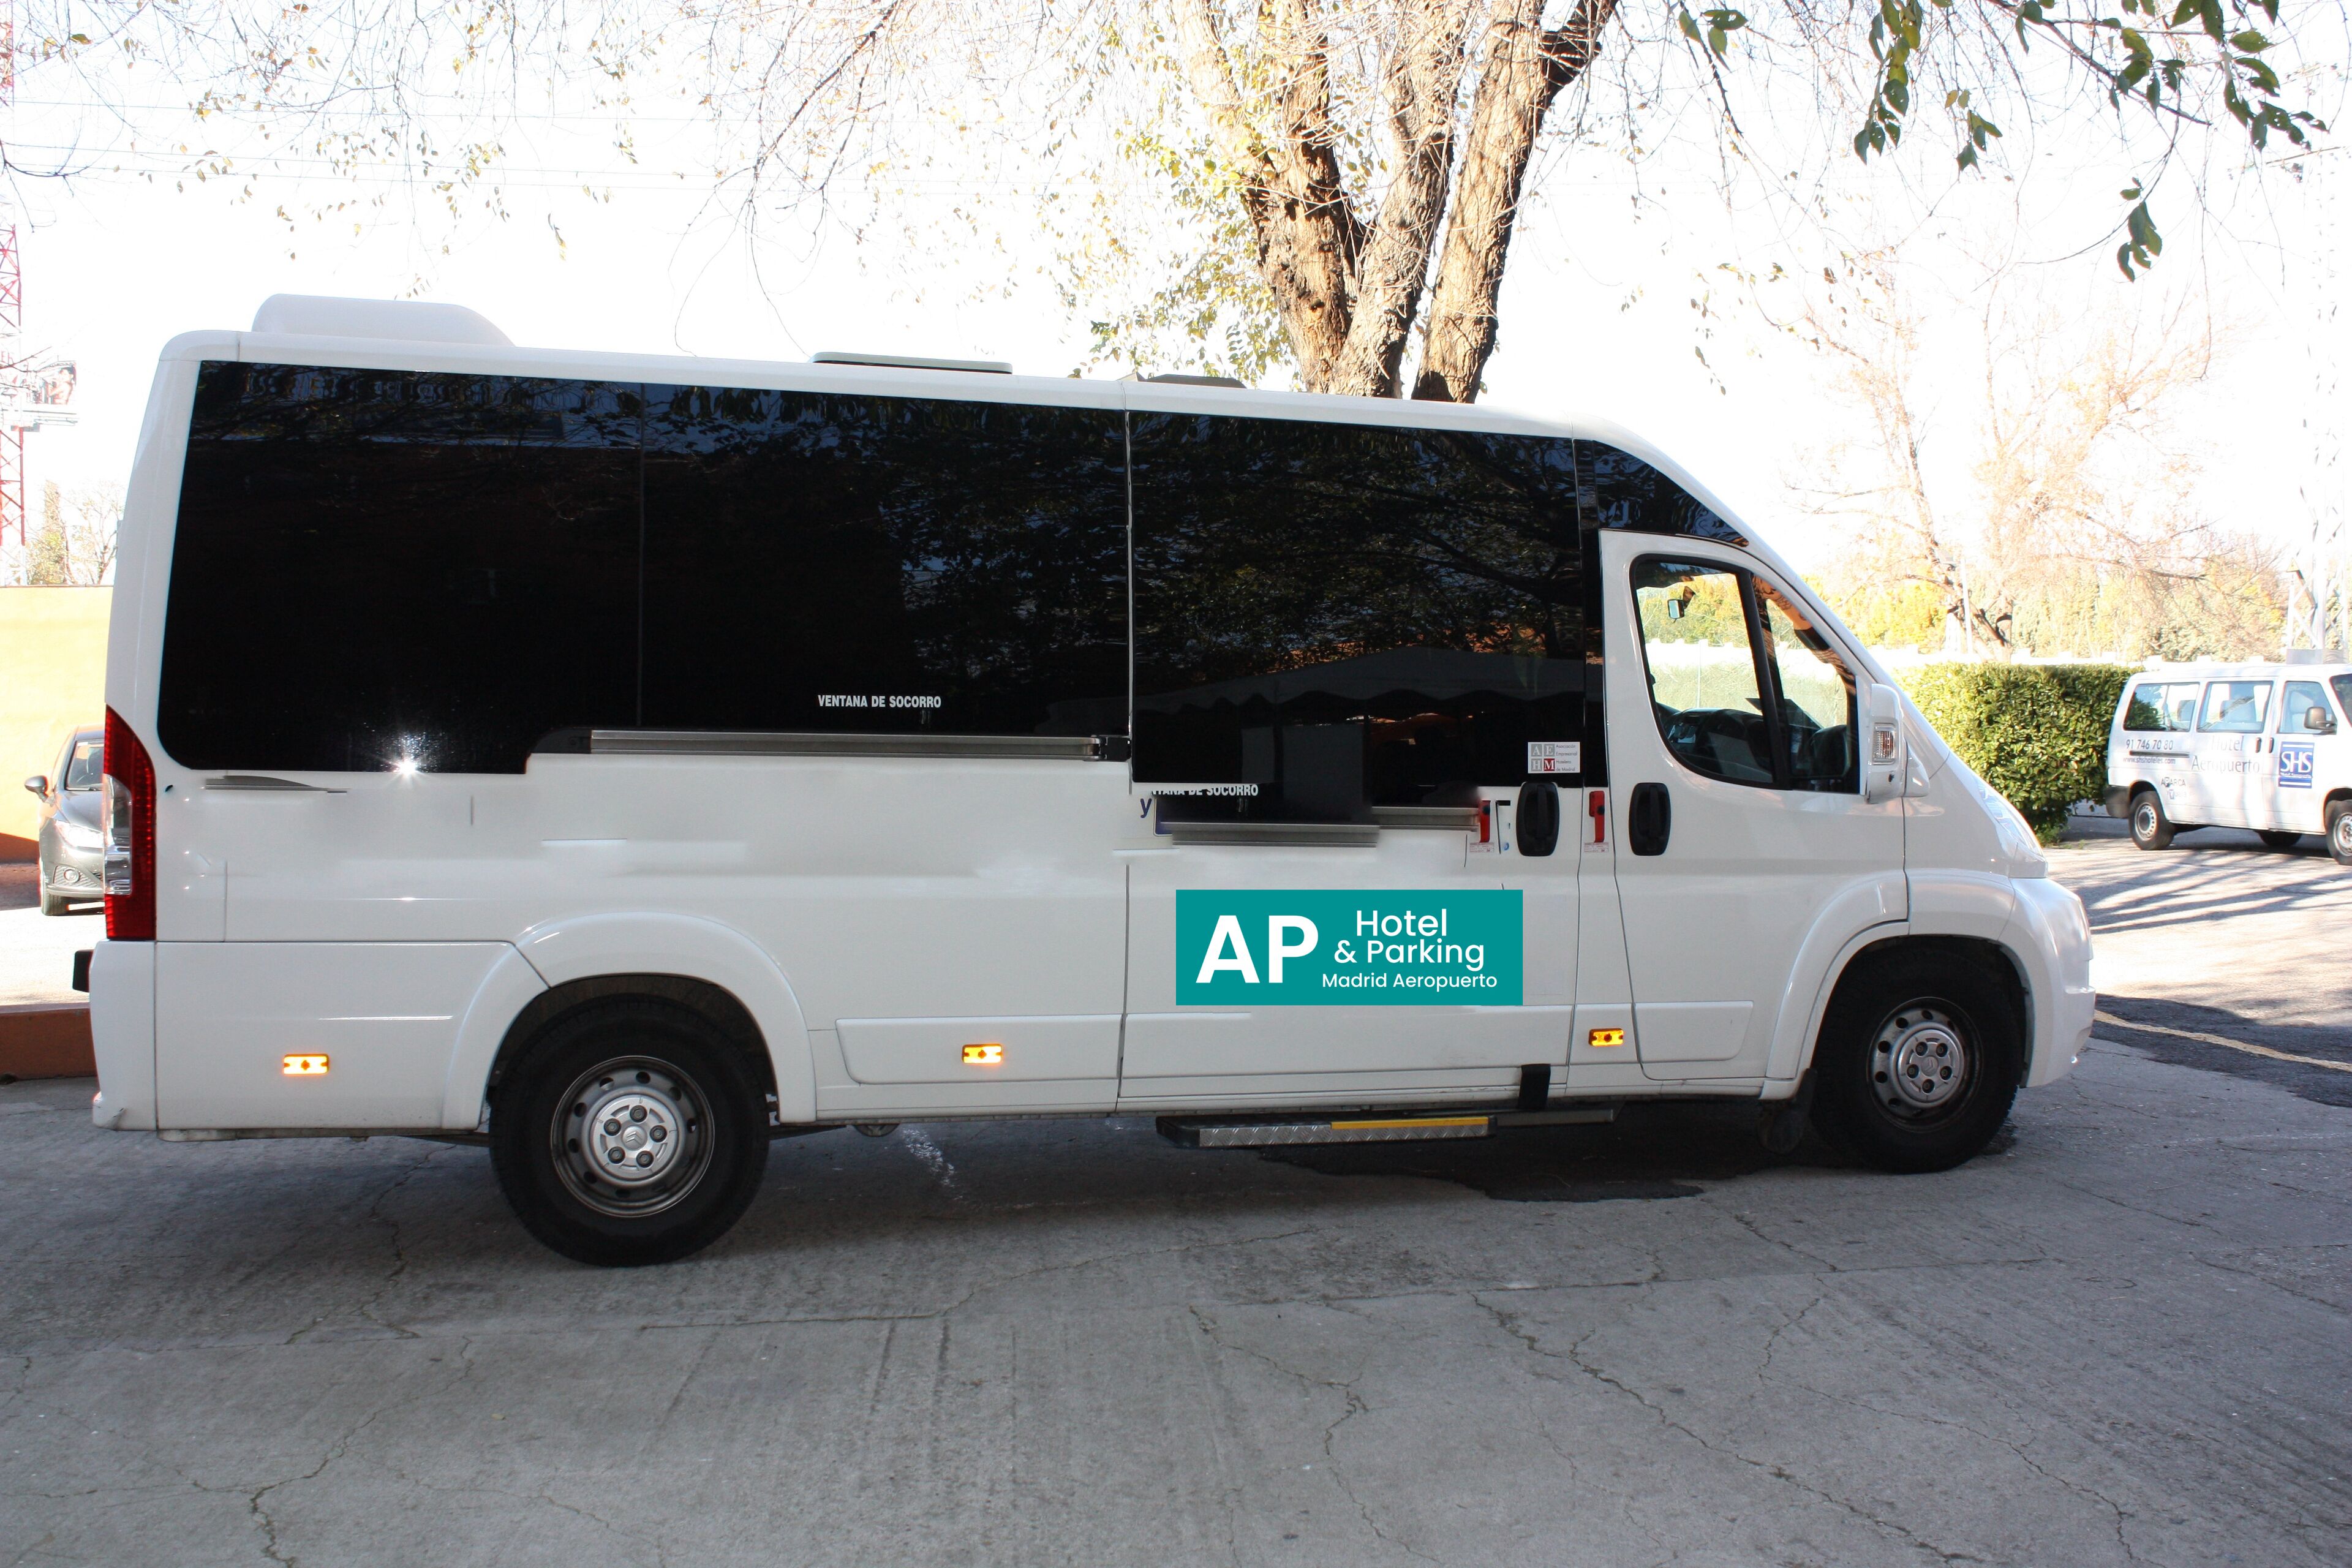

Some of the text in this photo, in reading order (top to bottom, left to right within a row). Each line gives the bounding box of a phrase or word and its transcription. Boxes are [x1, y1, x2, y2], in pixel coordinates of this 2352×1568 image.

[818, 695, 941, 708] VENTANA DE SOCORRO
[2126, 739, 2173, 750] 91 746 70 80
[2211, 735, 2244, 751] Hotel
[2191, 755, 2260, 774] Aeropuerto
[2280, 751, 2313, 773] SHS
[1140, 798, 1152, 818] y
[1356, 908, 1447, 937] Hotel
[1196, 915, 1319, 984] AP
[1334, 938, 1484, 971] & Parking
[1322, 973, 1498, 992] Madrid Aeropuerto
